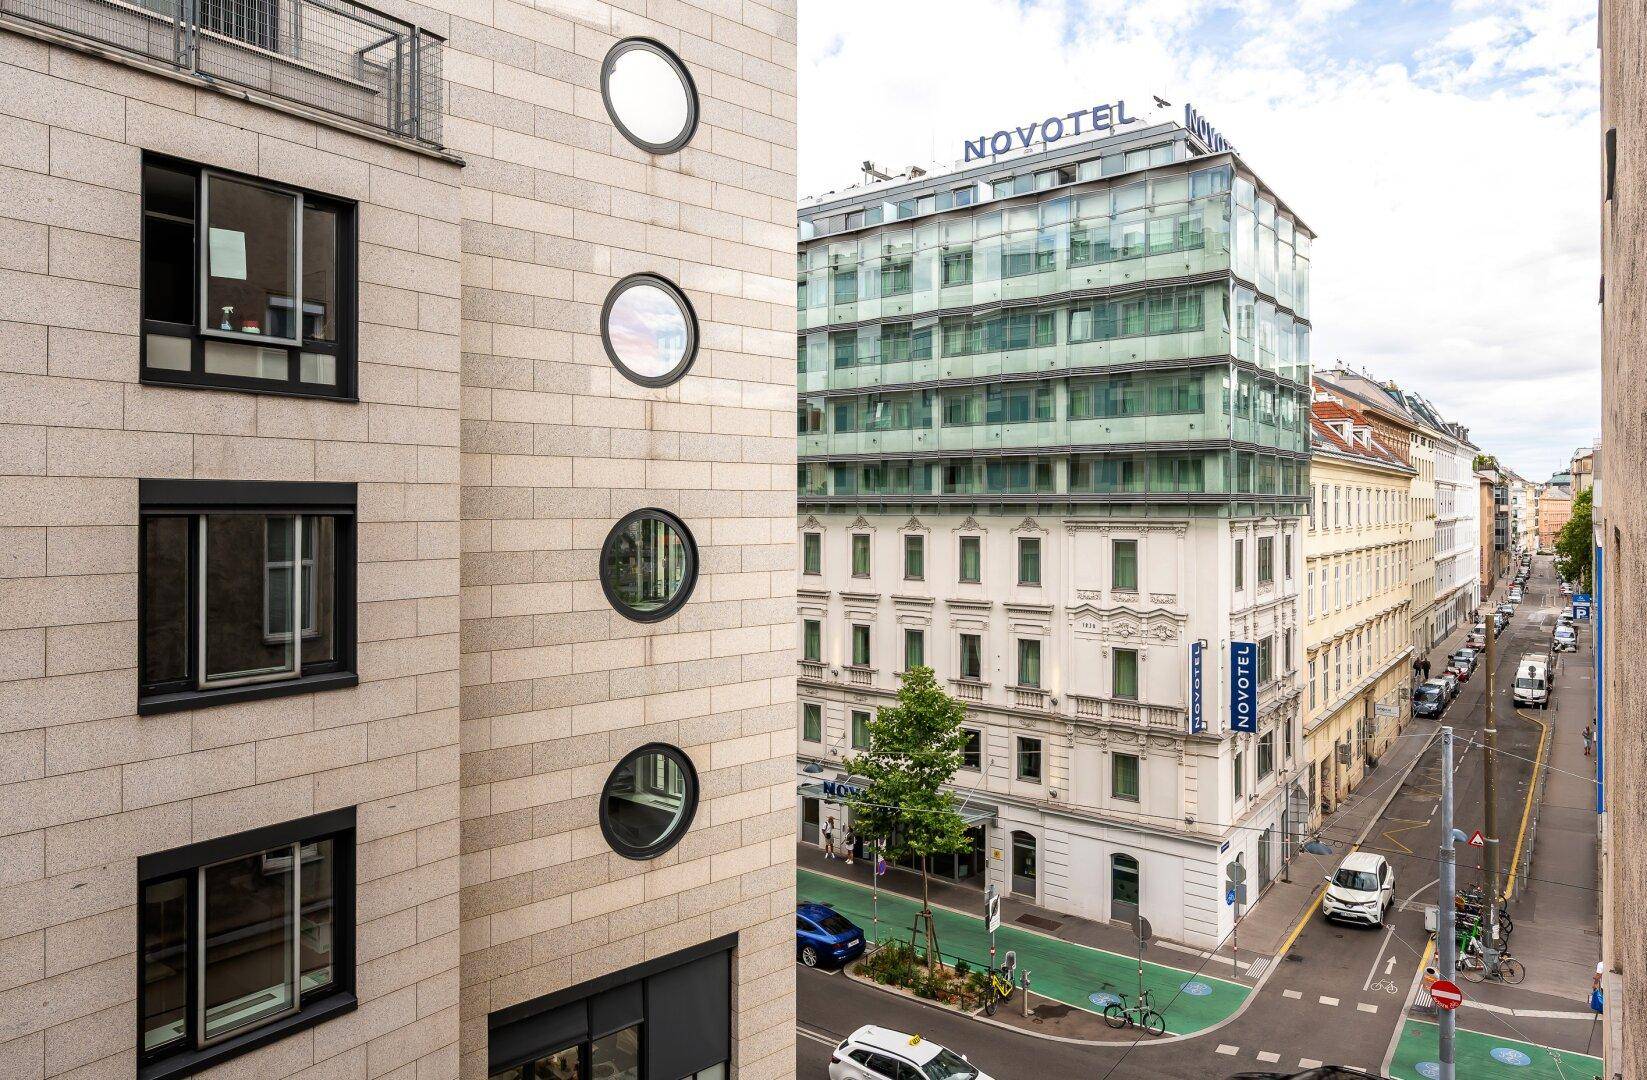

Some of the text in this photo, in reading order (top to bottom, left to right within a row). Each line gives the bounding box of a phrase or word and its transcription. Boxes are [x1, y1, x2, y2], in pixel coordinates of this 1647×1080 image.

[964, 100, 1136, 162] NOVOTEL
[1185, 103, 1234, 152] NOVO
[1238, 646, 1250, 728] NOVOTEL
